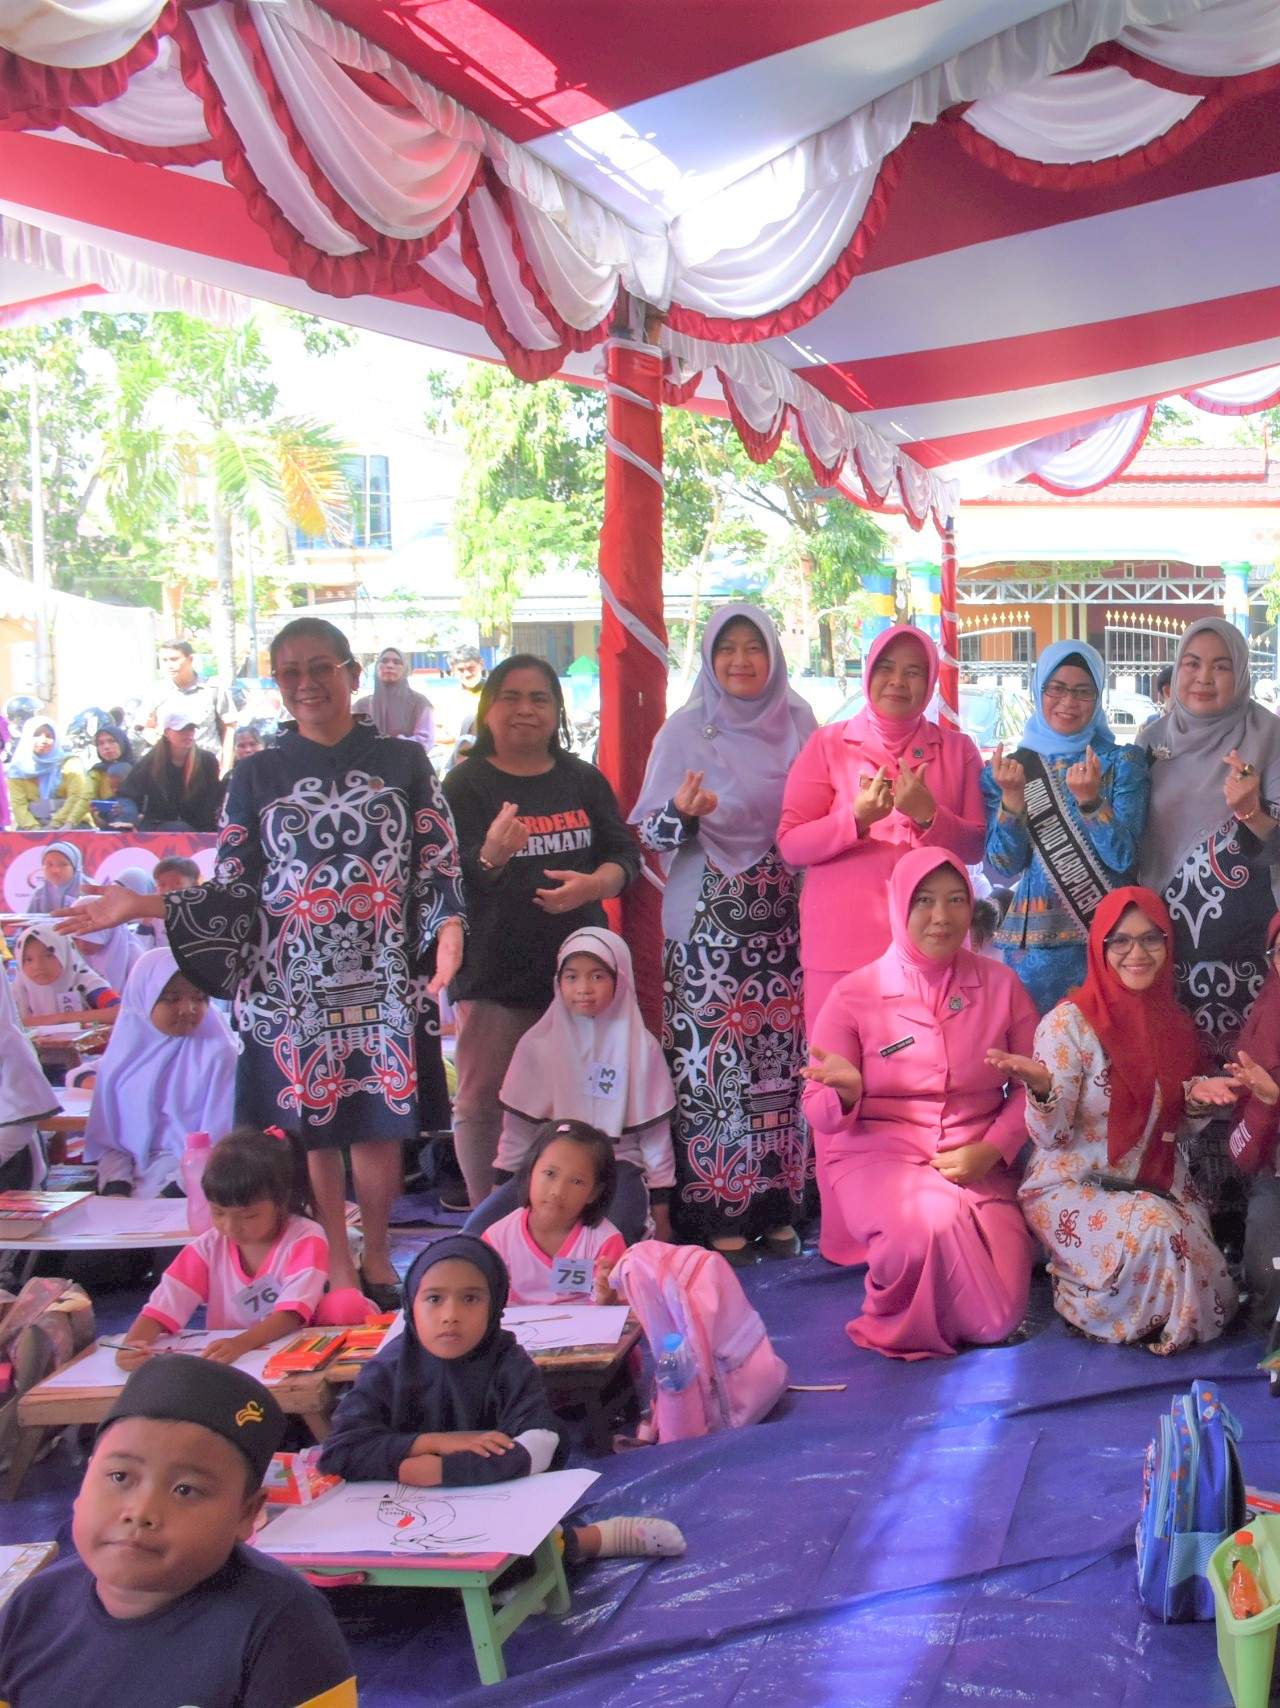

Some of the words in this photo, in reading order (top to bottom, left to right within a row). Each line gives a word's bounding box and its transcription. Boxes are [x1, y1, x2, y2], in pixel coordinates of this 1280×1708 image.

[1034, 815, 1069, 851] PAUD
[1049, 843, 1104, 916] KABUPATEN
[599, 1067, 616, 1094] 43
[558, 1268, 586, 1285] 75
[243, 1287, 279, 1313] 76
